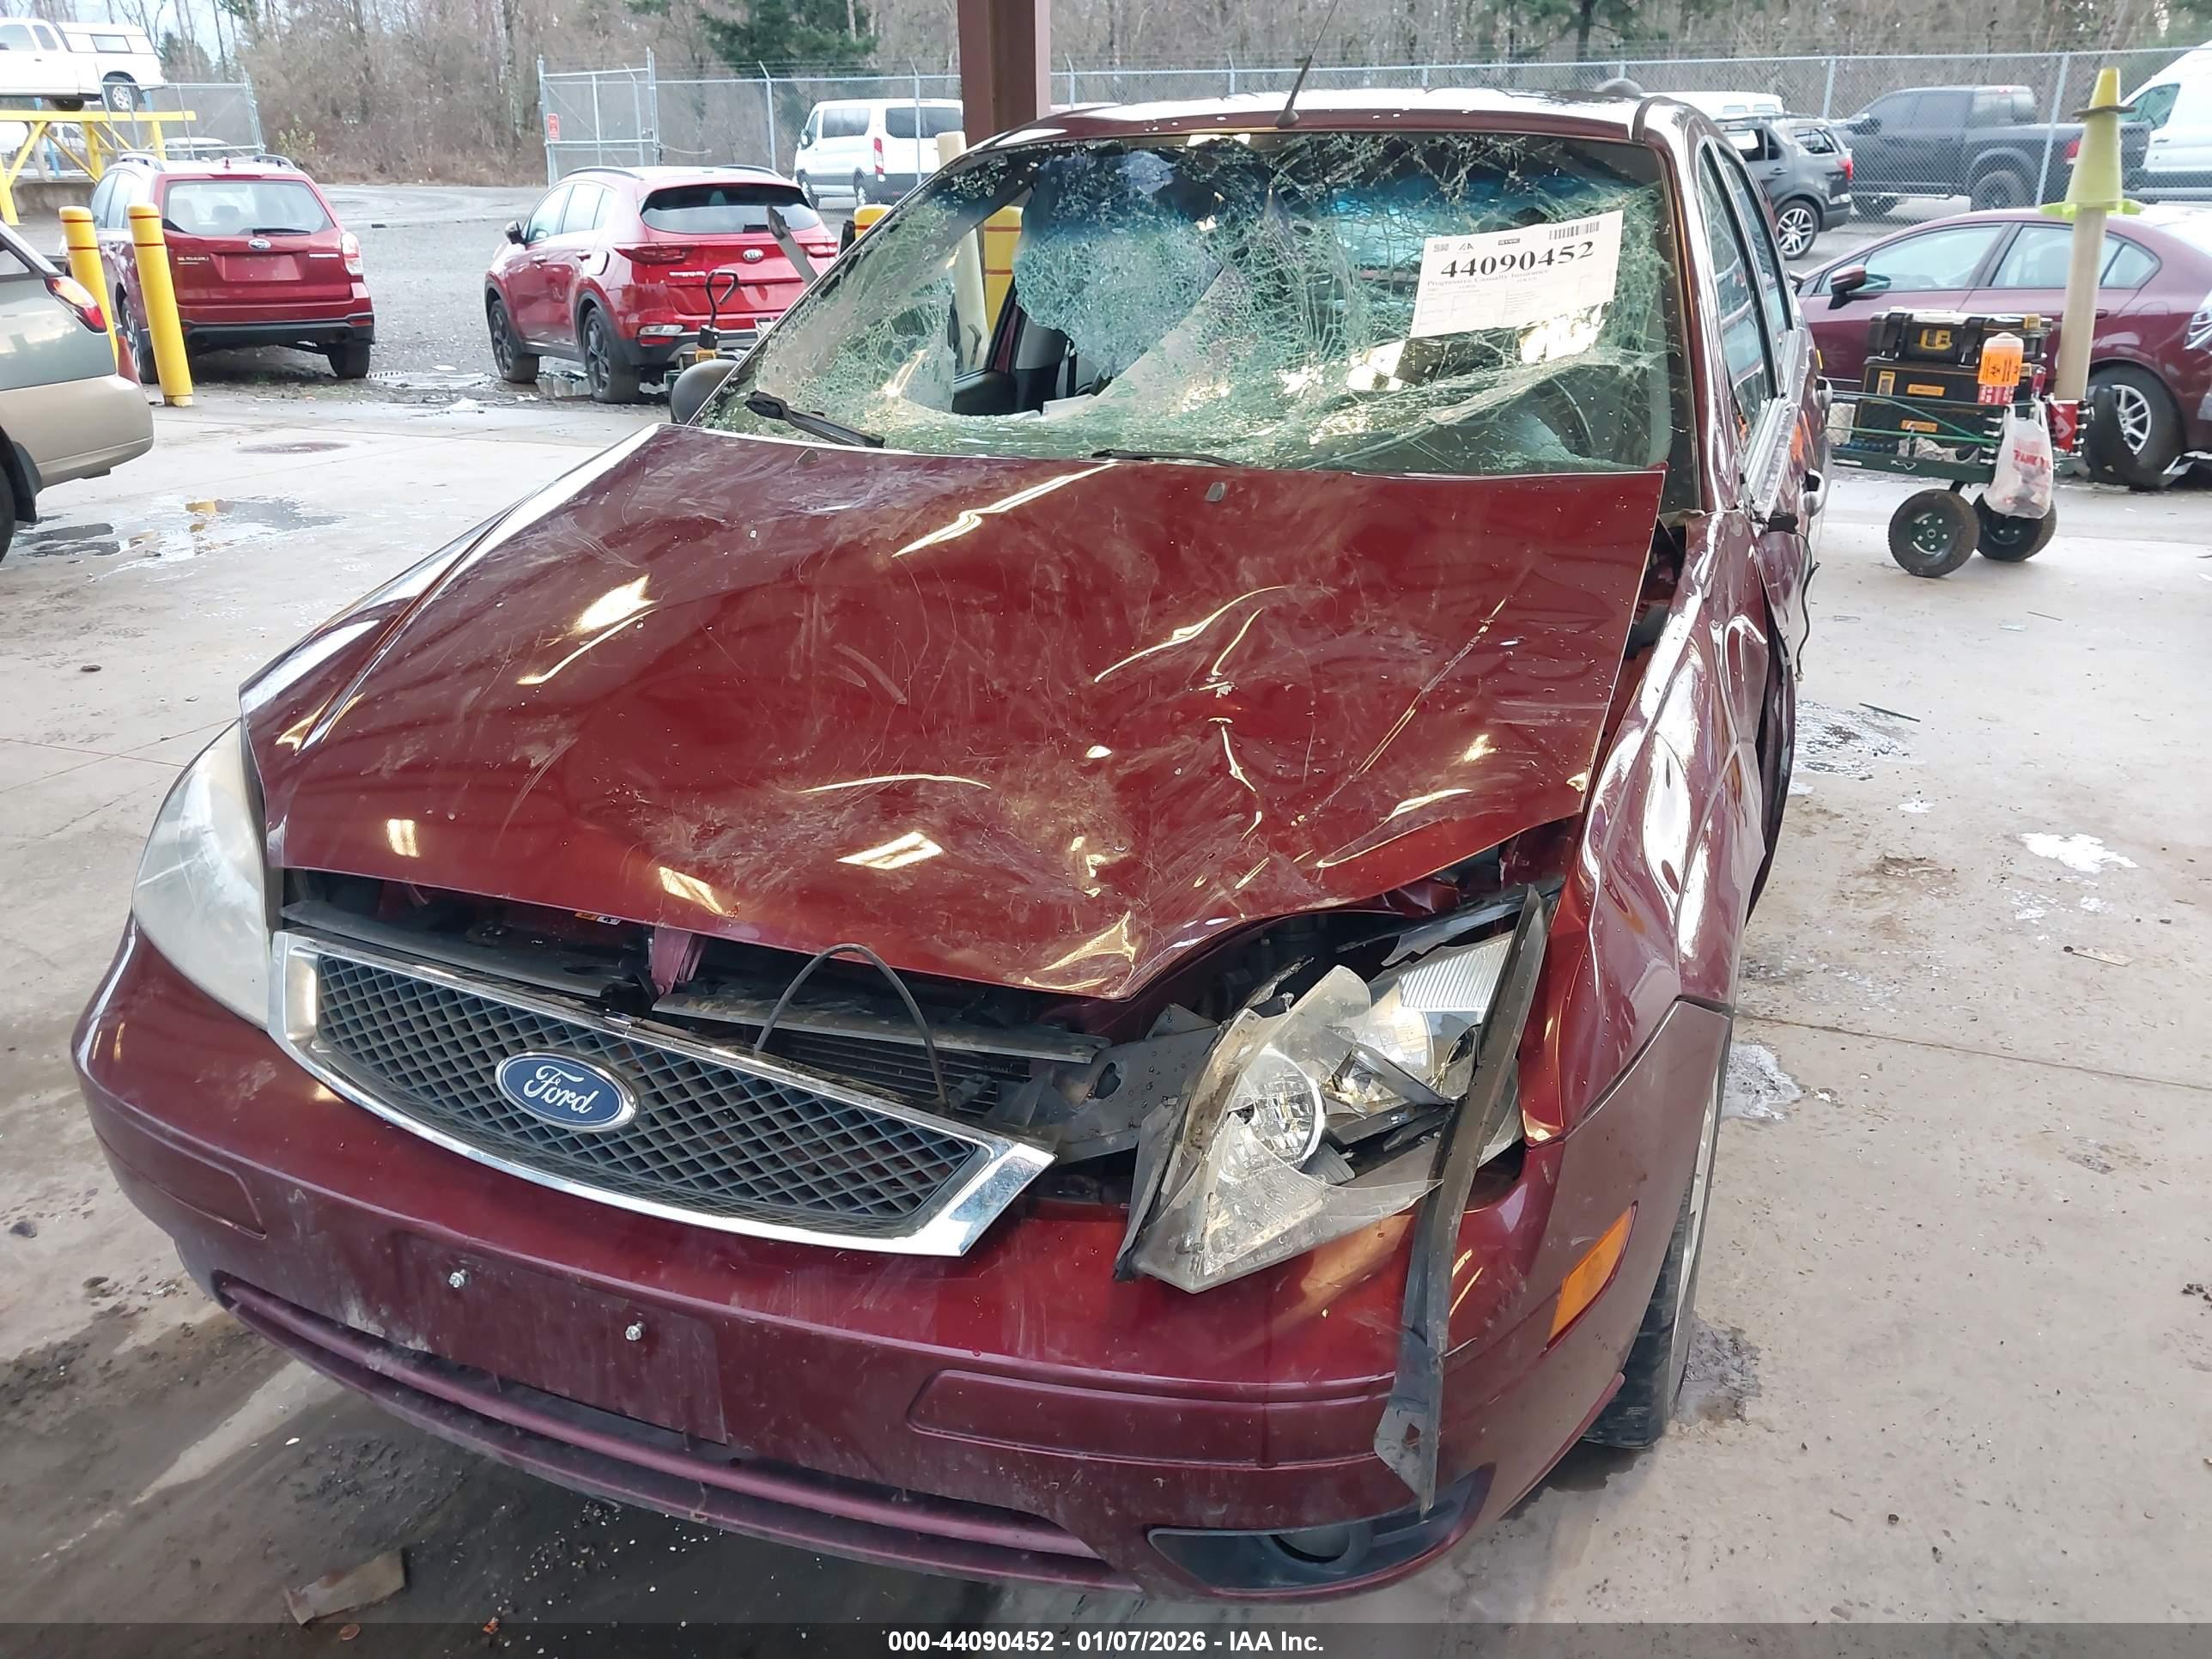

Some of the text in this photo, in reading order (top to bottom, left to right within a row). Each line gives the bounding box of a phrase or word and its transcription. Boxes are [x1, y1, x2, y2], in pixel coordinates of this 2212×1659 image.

[1440, 240, 1595, 278] 44090452
[1427, 278, 1474, 287] Progressive
[1474, 273, 1509, 283] Casualty
[523, 1065, 600, 1115] Ford
